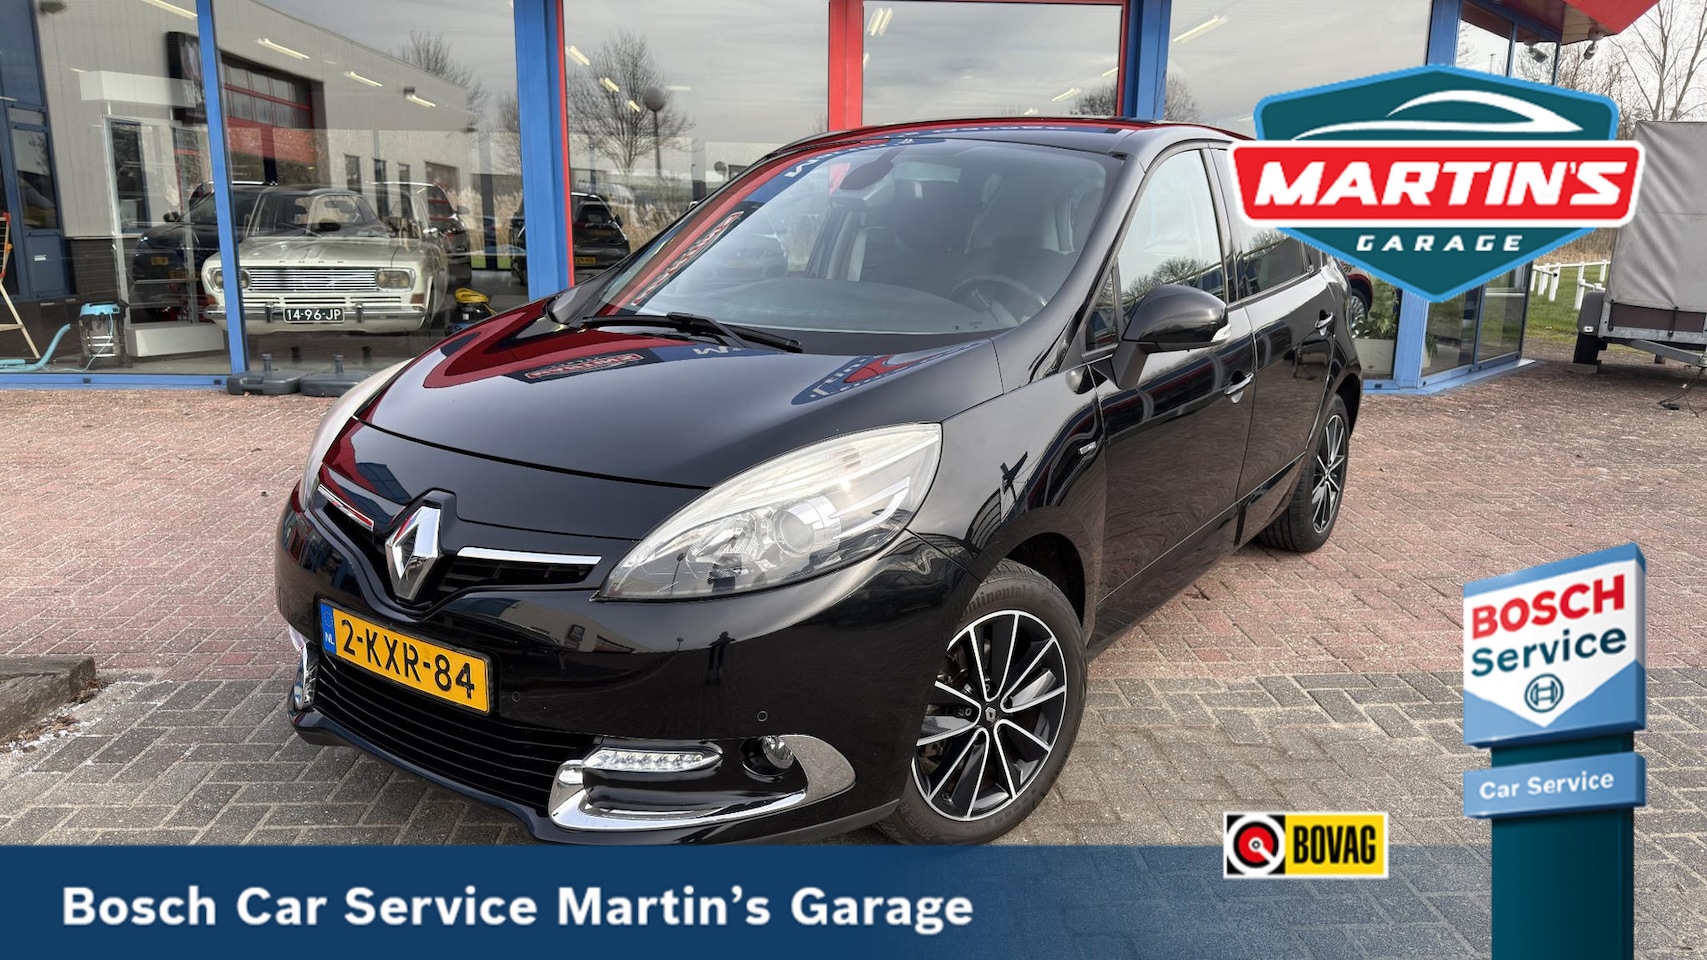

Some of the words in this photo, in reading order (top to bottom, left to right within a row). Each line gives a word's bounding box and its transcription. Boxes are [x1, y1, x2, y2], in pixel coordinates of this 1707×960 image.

[286, 308, 341, 321] 14-96-JP
[325, 631, 335, 646] NL
[341, 619, 475, 700] 2-KXR-84
